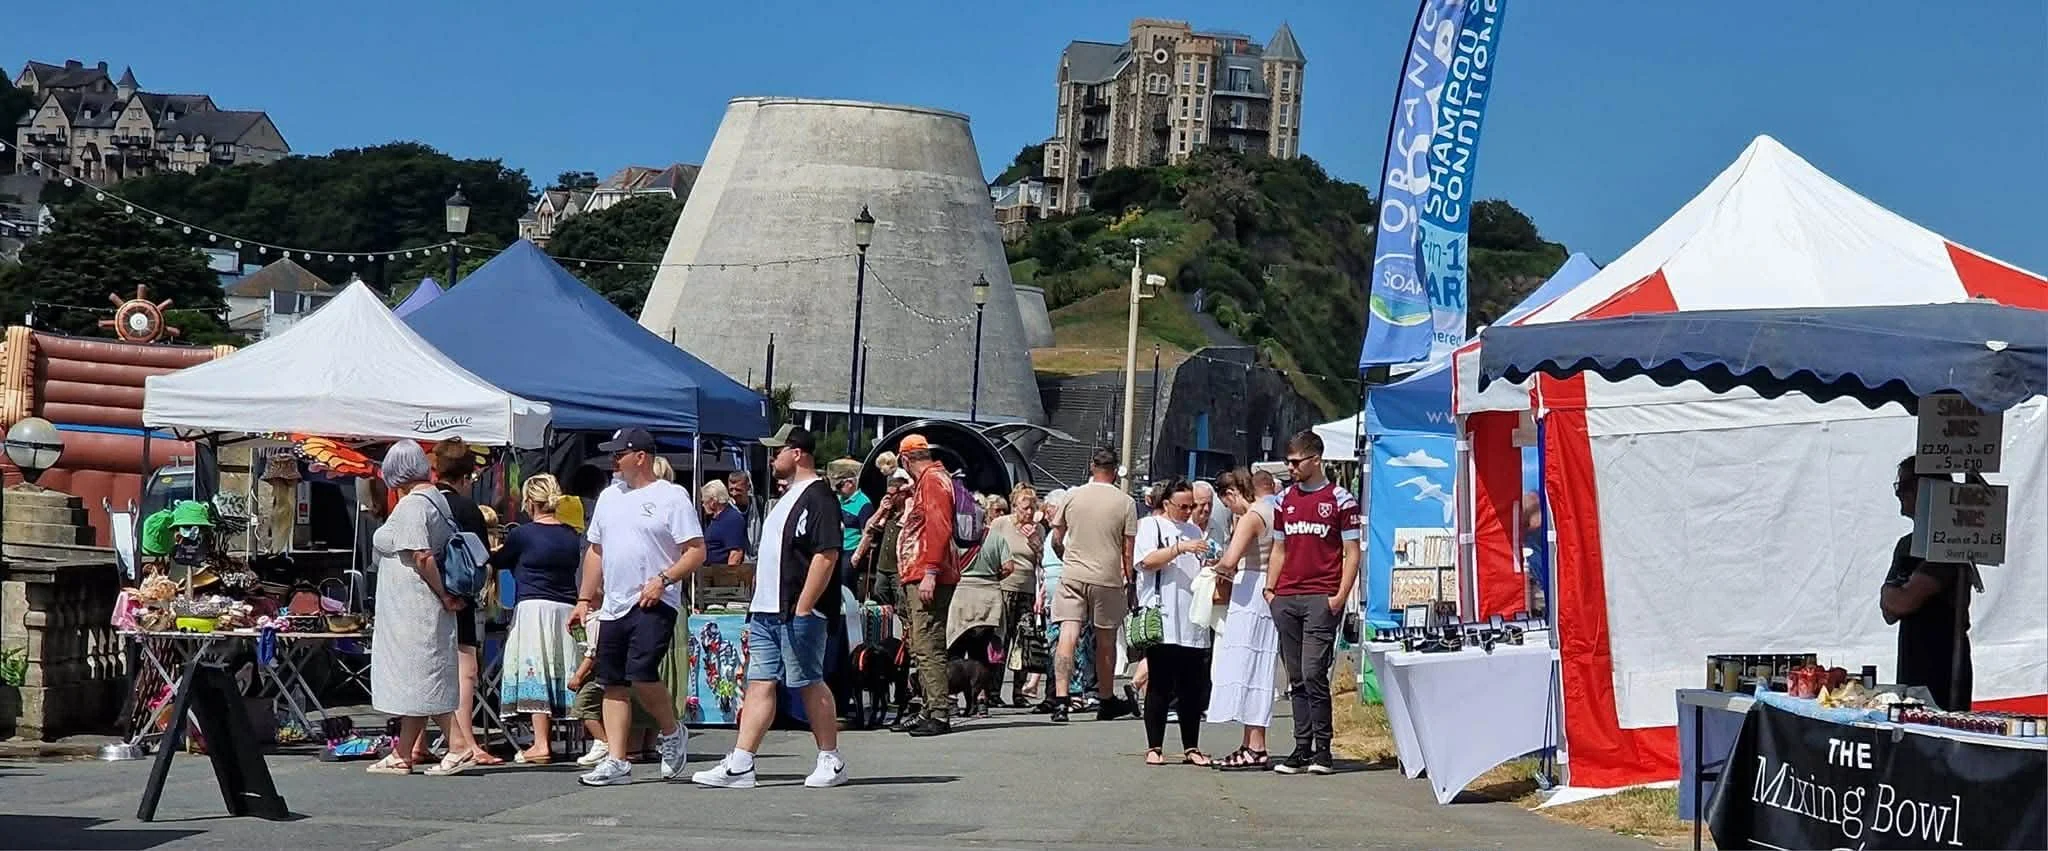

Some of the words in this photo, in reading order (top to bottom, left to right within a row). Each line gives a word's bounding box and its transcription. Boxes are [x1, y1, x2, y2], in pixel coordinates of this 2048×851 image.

[413, 412, 472, 433] Airwave
[1922, 444, 1949, 454] £2.50
[1984, 443, 1995, 454] £7
[1944, 456, 1952, 468] 5
[1284, 521, 1331, 538] betway
[1934, 531, 1946, 543] £2
[1972, 532, 1979, 544] 3
[1828, 738, 1873, 769] THE
[1752, 755, 1865, 838] Mixing
[1871, 783, 1963, 846] Bowl
